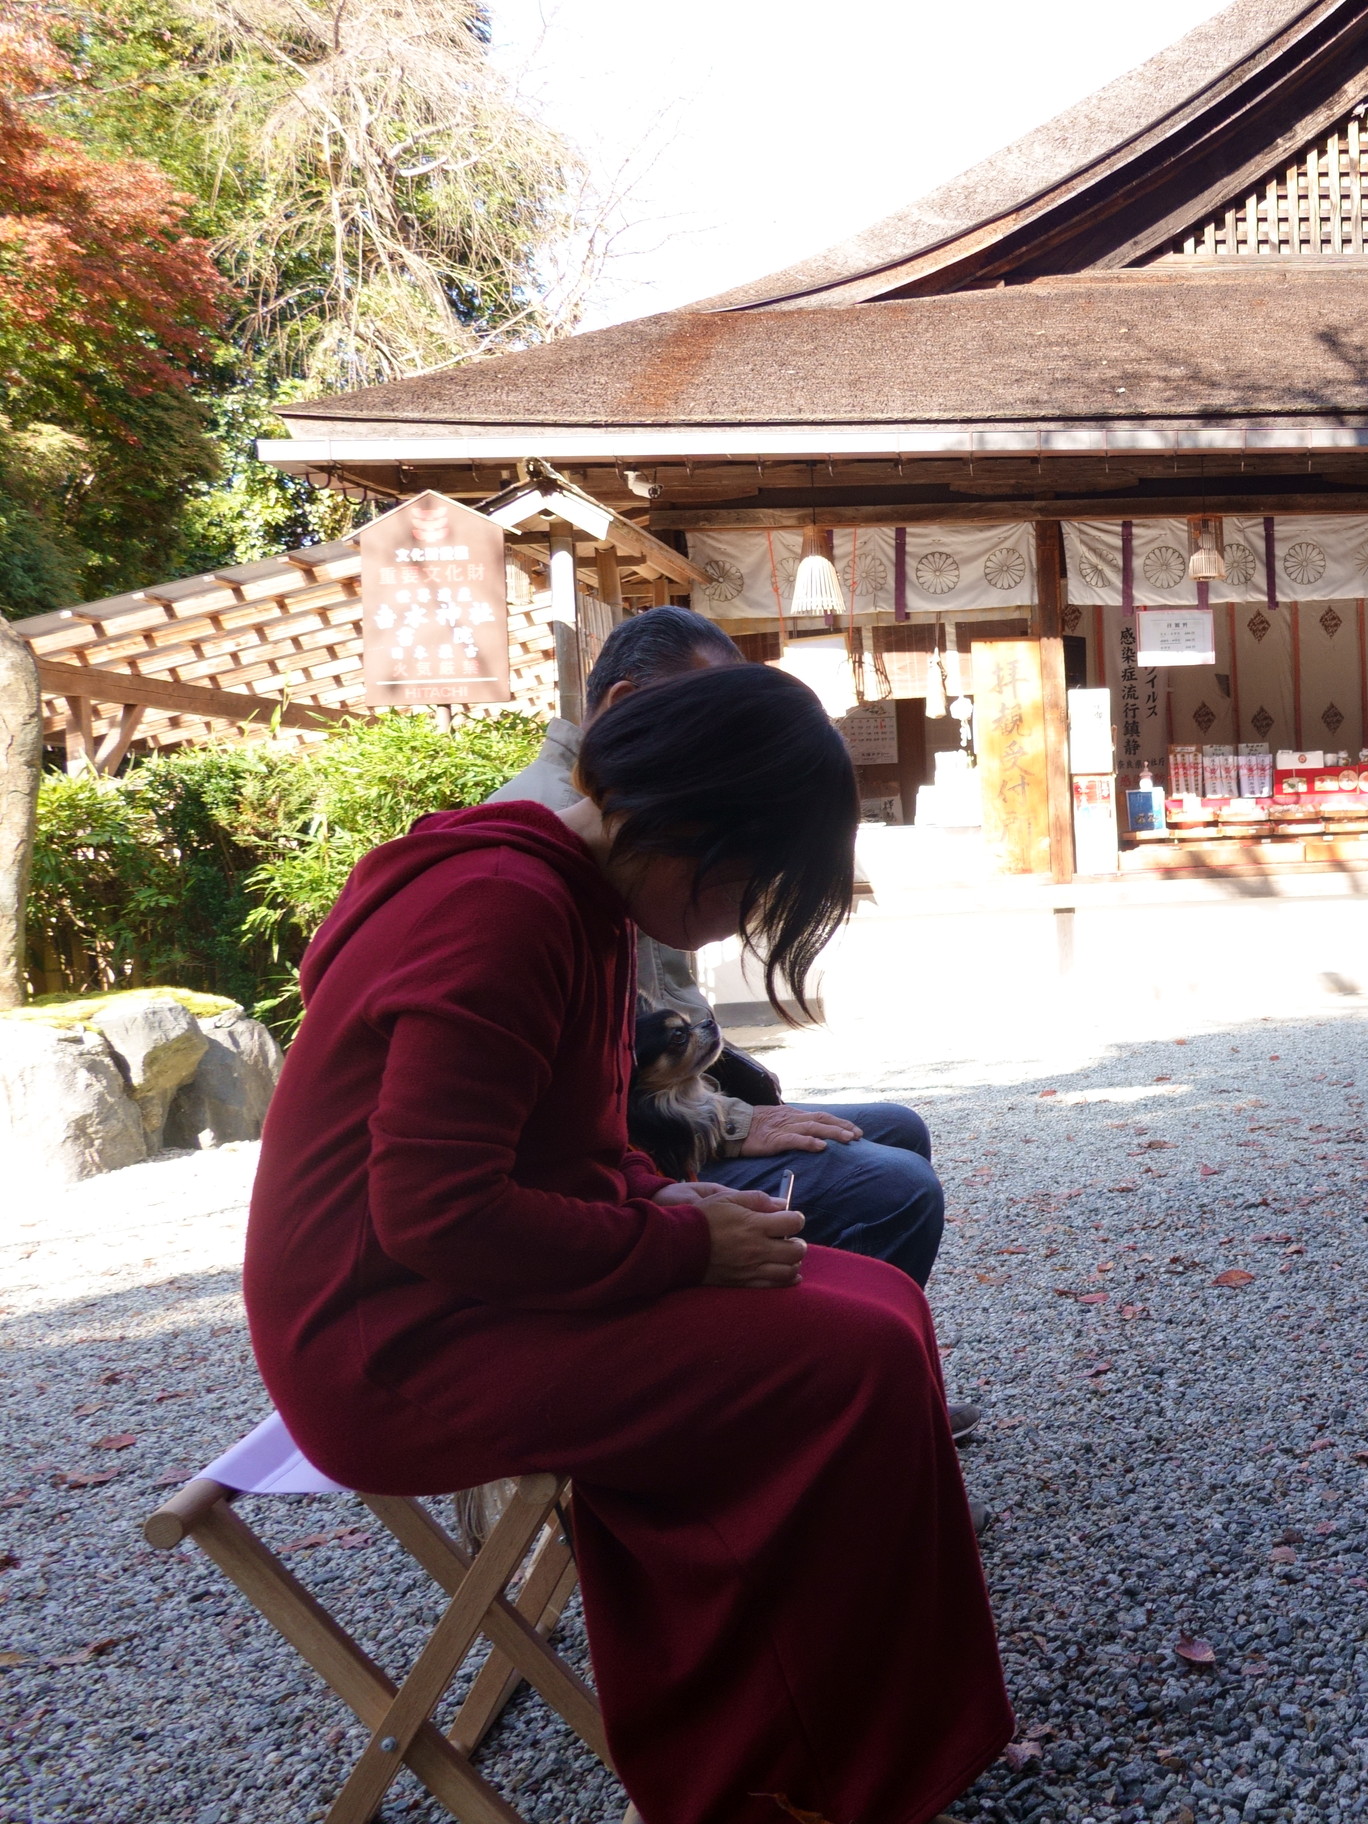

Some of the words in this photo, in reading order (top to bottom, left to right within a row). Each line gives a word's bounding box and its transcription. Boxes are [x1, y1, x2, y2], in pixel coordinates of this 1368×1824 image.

[379, 563, 485, 585] 重要文化財
[404, 686, 469, 699] HITACHI
[1119, 626, 1142, 756] 感染症流行鎮静
[1117, 757, 1165, 769] 奈良県社庁
